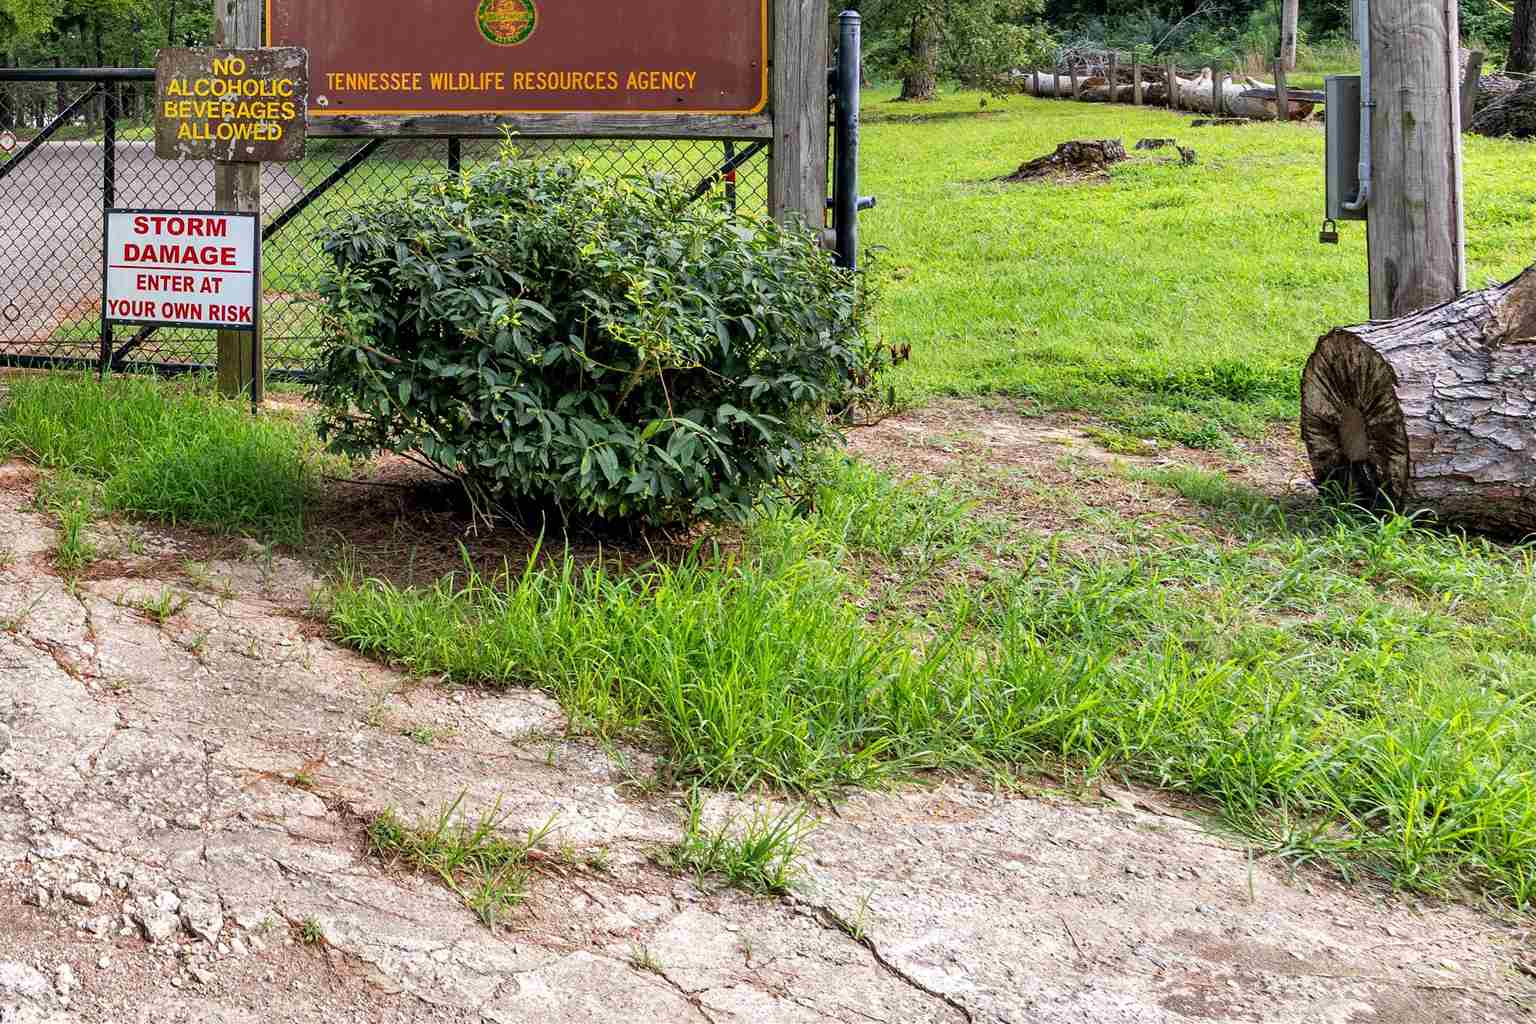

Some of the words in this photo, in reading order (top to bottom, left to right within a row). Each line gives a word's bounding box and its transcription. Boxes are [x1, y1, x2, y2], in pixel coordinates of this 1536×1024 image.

[213, 58, 246, 76] NO
[166, 79, 293, 97] ALCOHOLIC
[326, 72, 422, 91] TENNESSEE
[430, 72, 505, 90] WILDLIFE
[513, 71, 619, 90] RESOURCES
[627, 71, 697, 89] AGENCY
[164, 102, 296, 120] BEVERAGES
[177, 122, 283, 141] ALLOWED
[134, 216, 226, 236] STORM
[124, 244, 236, 265] DAMAGE
[136, 275, 194, 291] ENTER
[200, 277, 222, 293] AT
[108, 299, 155, 317] YOUR
[161, 302, 202, 320] OWN
[209, 305, 251, 321] RISK
